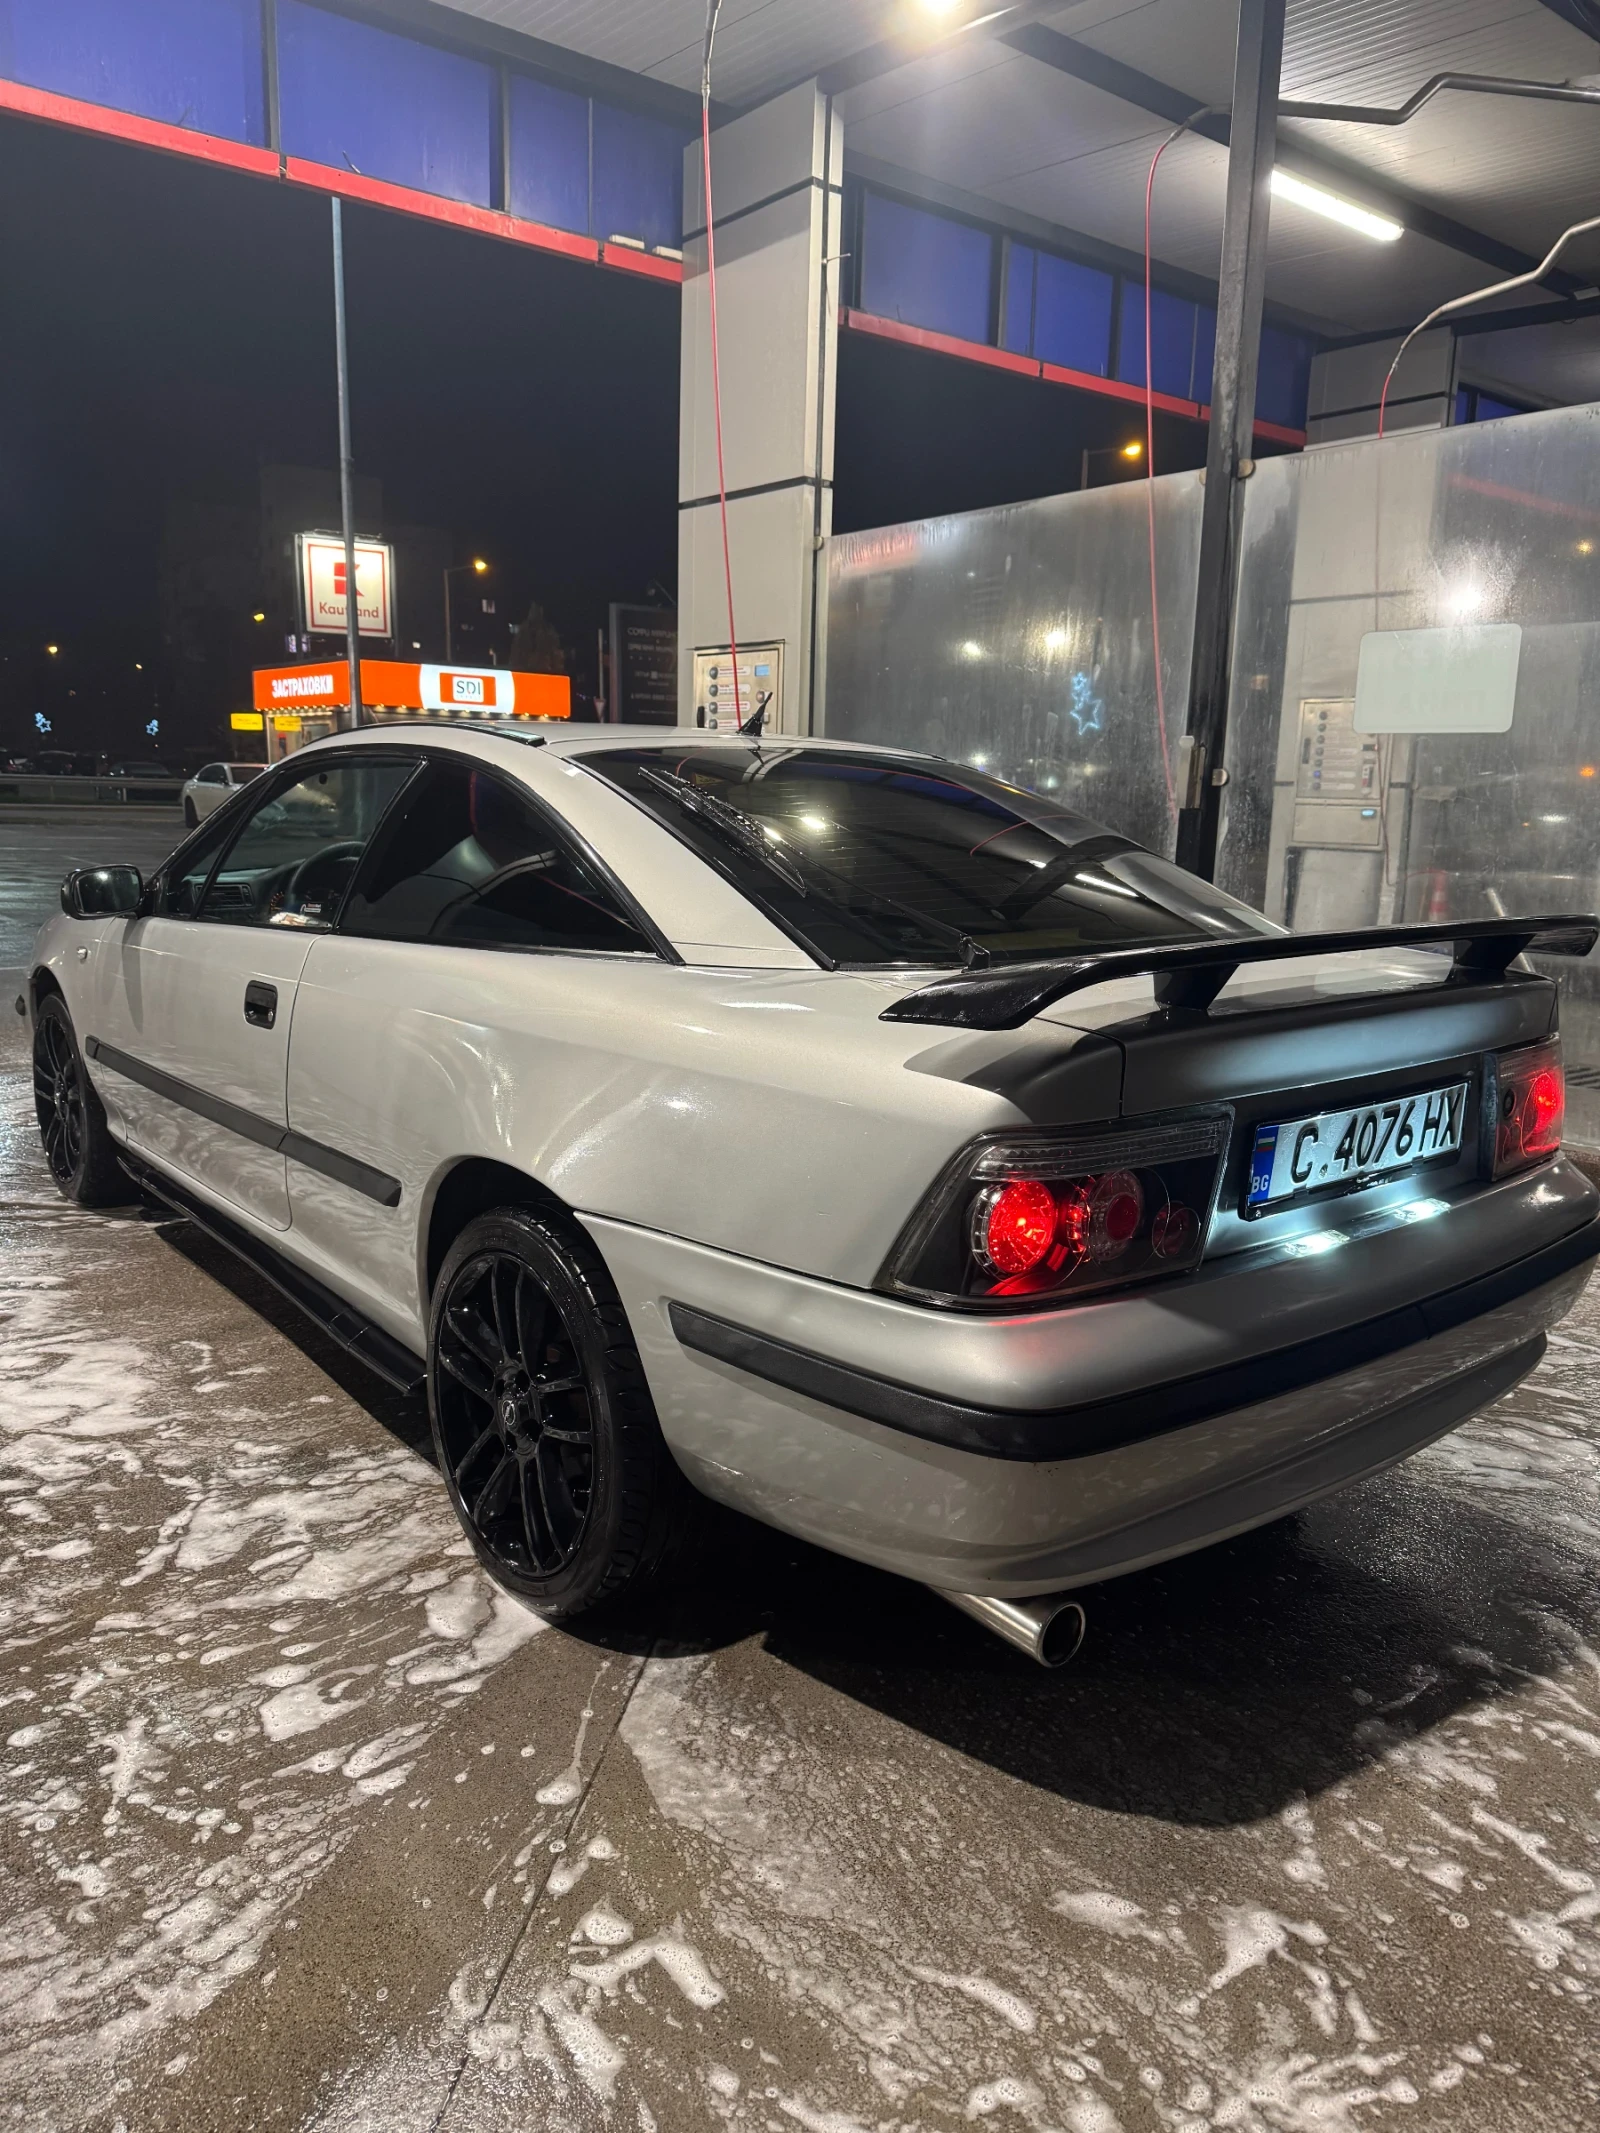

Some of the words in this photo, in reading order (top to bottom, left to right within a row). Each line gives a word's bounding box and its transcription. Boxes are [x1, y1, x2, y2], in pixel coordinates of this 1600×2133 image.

[319, 601, 379, 619] Kauand
[271, 674, 334, 698] ЗАСТРАХОВКИ
[456, 680, 481, 695] SDI
[1251, 1174, 1269, 1193] BG
